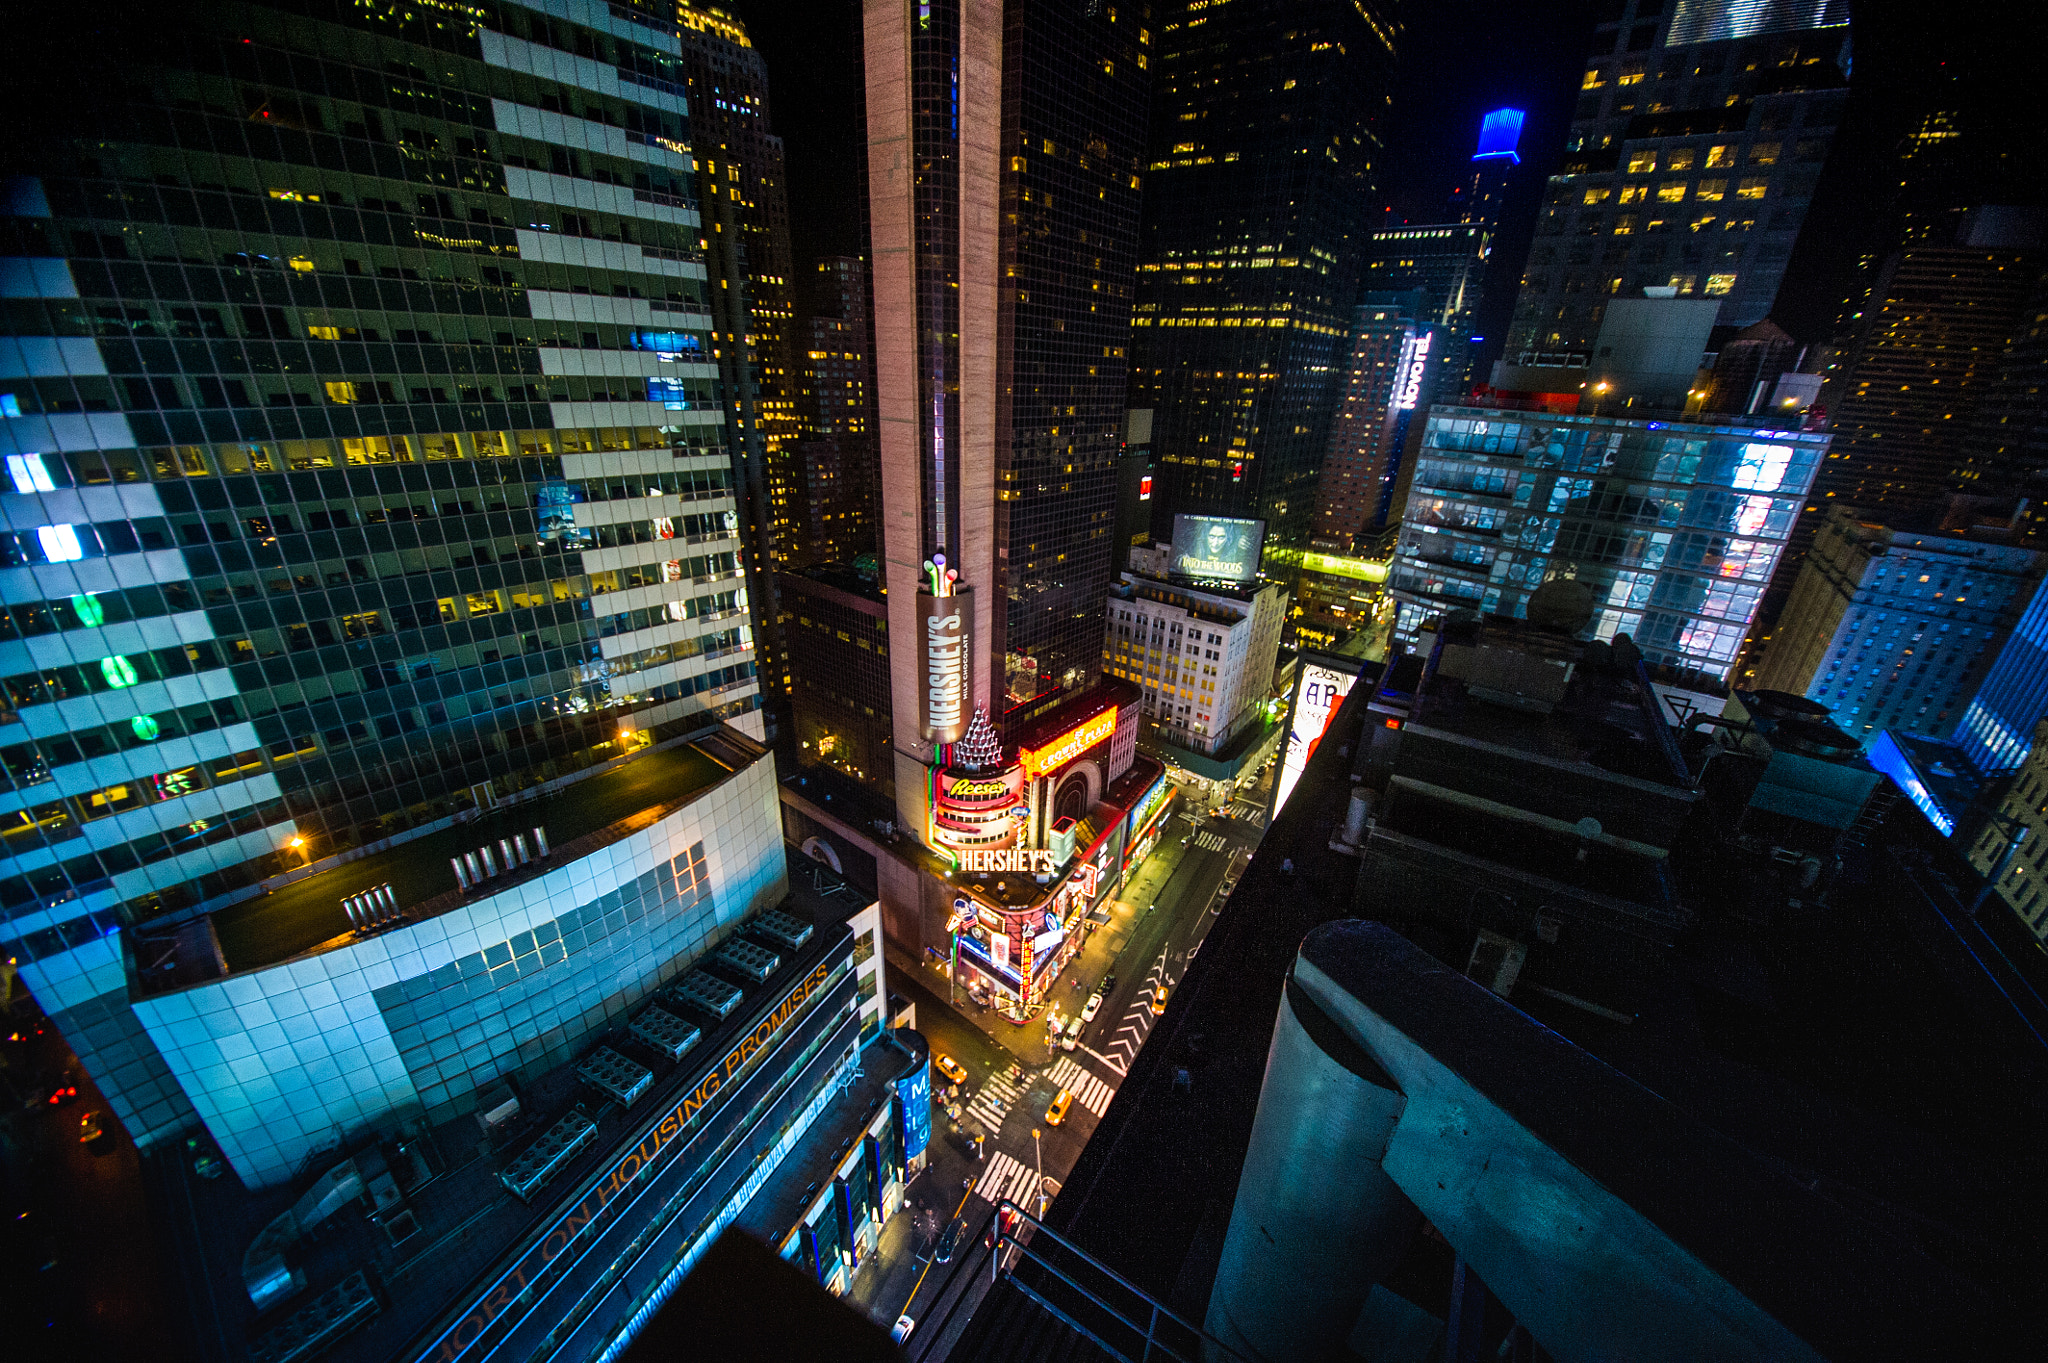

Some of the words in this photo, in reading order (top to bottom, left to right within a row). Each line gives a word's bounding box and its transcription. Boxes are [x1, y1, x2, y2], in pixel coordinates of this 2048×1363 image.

[1401, 332, 1432, 410] NOVOTEL
[1182, 556, 1200, 569] INTO
[1201, 560, 1212, 570] THE
[1213, 559, 1243, 574] WOODS
[928, 615, 961, 727] HERSHEY'S
[1040, 738, 1084, 771] CROWNE
[1085, 720, 1113, 745] PLAZA
[951, 779, 1006, 796] Reese's
[961, 849, 1055, 872] HERSHEY'S
[542, 1202, 592, 1261] ON
[596, 1072, 721, 1206] HOUSING
[725, 964, 828, 1078] PROMISES
[739, 1141, 786, 1203] BROADWAY
